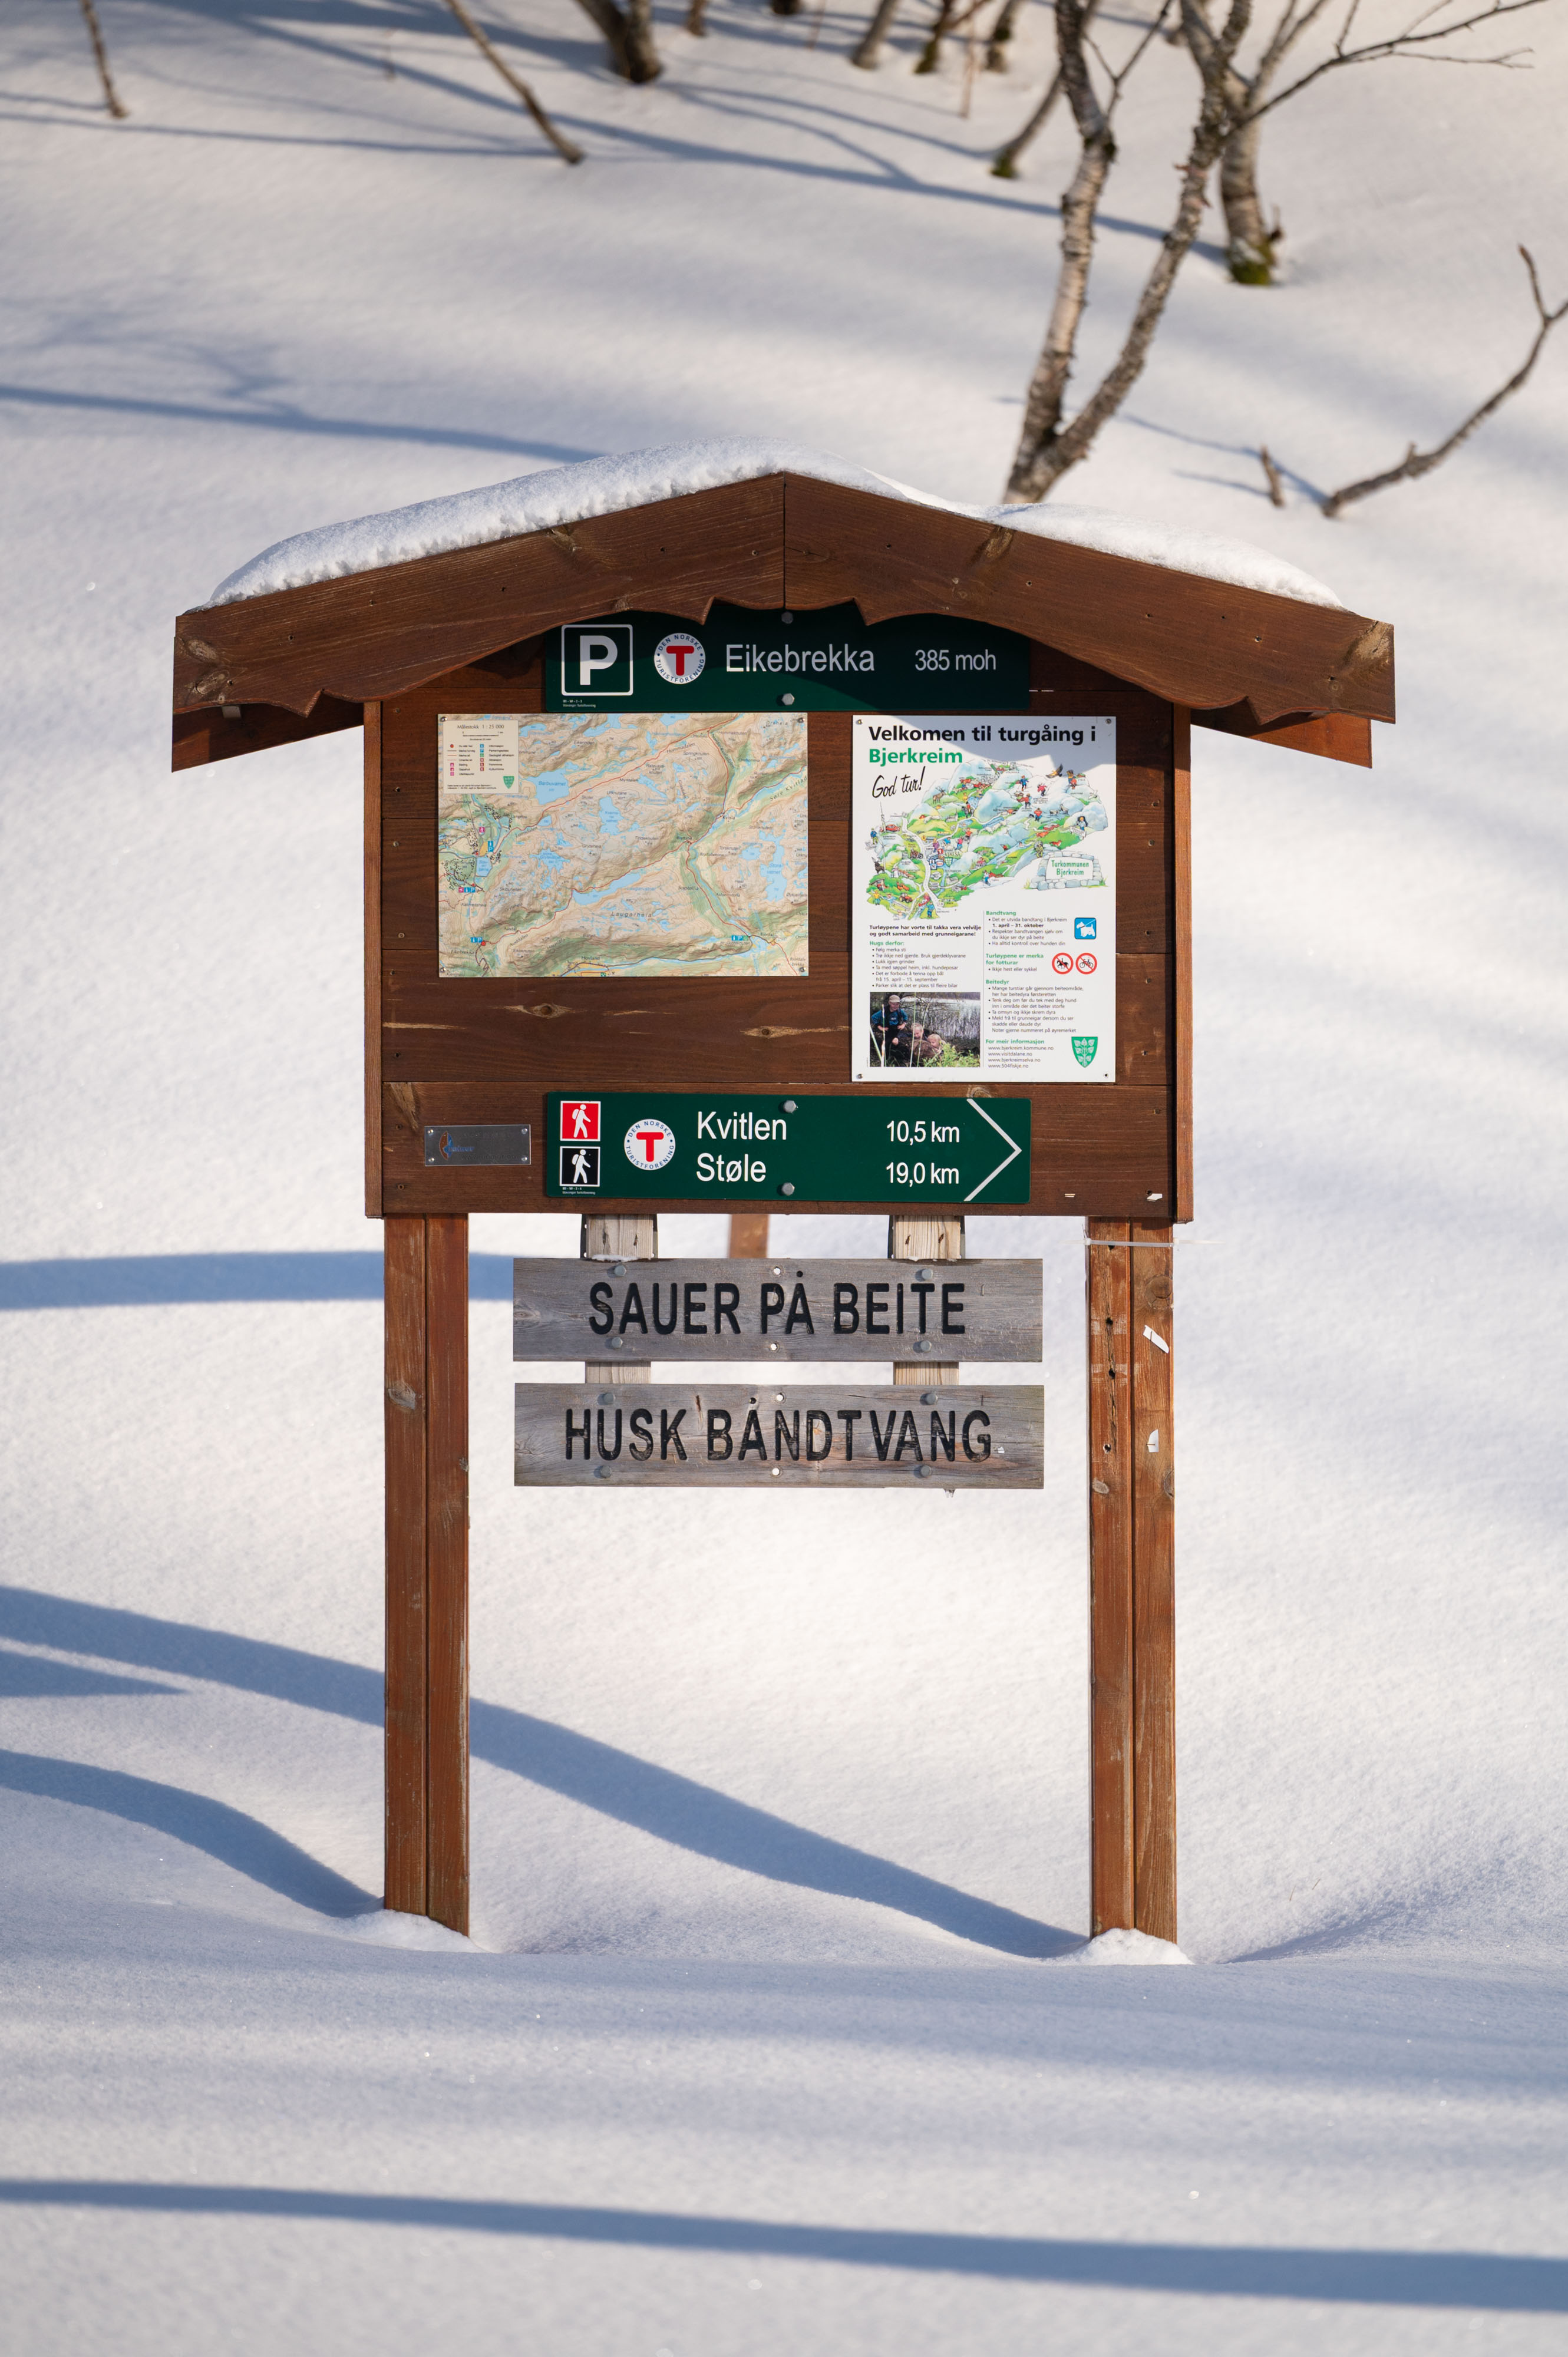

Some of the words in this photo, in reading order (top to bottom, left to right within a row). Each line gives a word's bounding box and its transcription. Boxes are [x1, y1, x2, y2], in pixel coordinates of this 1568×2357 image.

[658, 638, 671, 651] DEN
[674, 635, 702, 651] NORSKE
[580, 635, 618, 685] P
[656, 659, 705, 683] TURISTFORENING
[666, 645, 694, 676] T
[726, 644, 874, 672] Eikebrekka
[915, 650, 950, 671] 385
[955, 649, 996, 671] moh
[869, 726, 965, 741] Velkomen
[972, 726, 991, 741] til
[998, 724, 1084, 745] turgåing
[1091, 726, 1095, 741] i
[869, 748, 962, 767] Bjerkreim
[872, 775, 897, 798] God
[901, 766, 925, 793] tur!
[1057, 868, 1084, 877] Bjerkreim
[628, 1124, 641, 1137] DEN
[644, 1121, 672, 1137] NORSKE
[697, 1111, 787, 1141] Kvitlen
[887, 1121, 926, 1146] 10,5
[931, 1121, 960, 1143] km
[626, 1146, 674, 1169] TURISTFORENING
[636, 1132, 664, 1162] T
[696, 1153, 766, 1183] Støle
[886, 1163, 926, 1187] 19,0
[930, 1163, 959, 1184] km
[589, 1282, 741, 1335] SAUER
[760, 1270, 815, 1335] PÅ
[834, 1282, 965, 1335] BEITE
[565, 1408, 688, 1461] HUSK
[707, 1397, 991, 1463] BÅNDTVANG
